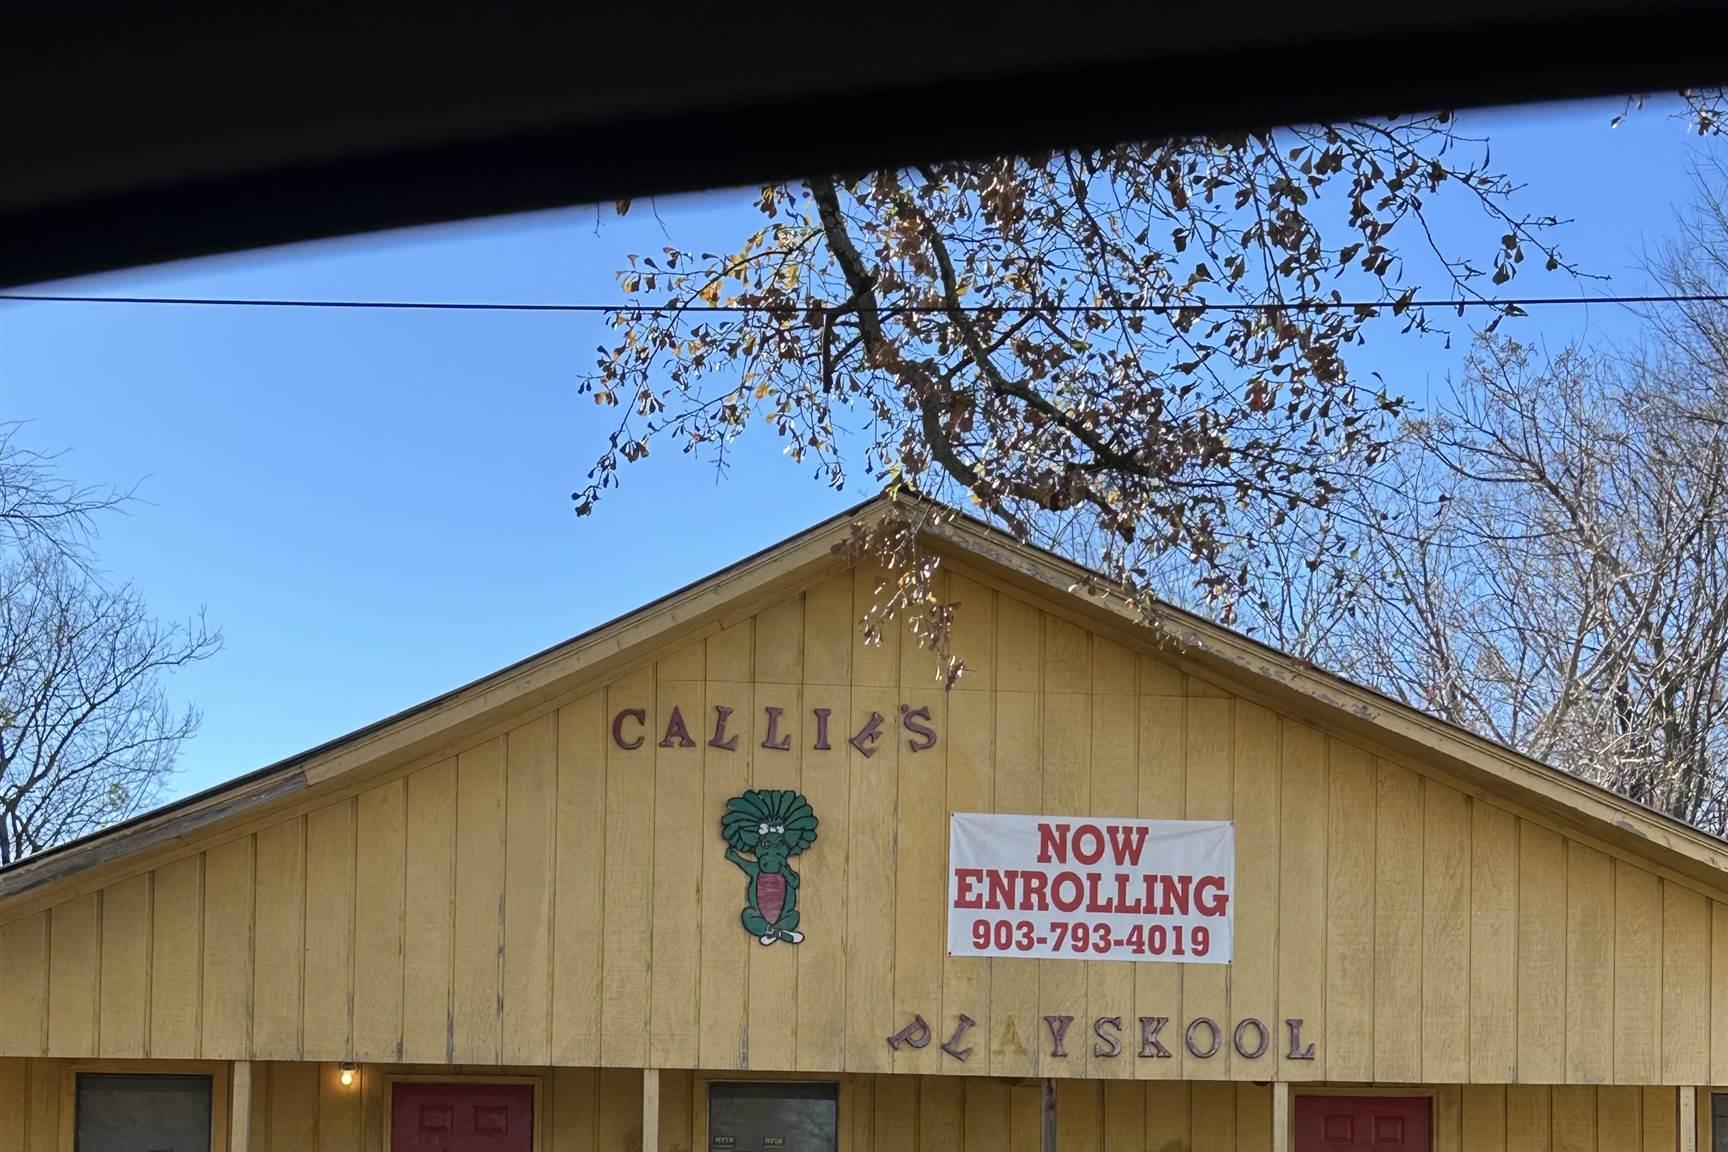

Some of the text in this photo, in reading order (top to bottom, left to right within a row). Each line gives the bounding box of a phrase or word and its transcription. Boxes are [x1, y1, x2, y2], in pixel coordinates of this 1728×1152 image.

[612, 705, 938, 758] CALLIE'S
[1036, 823, 1149, 866] NOW
[953, 868, 1230, 917] ENROLLING
[972, 919, 1210, 956] 903-793-4019
